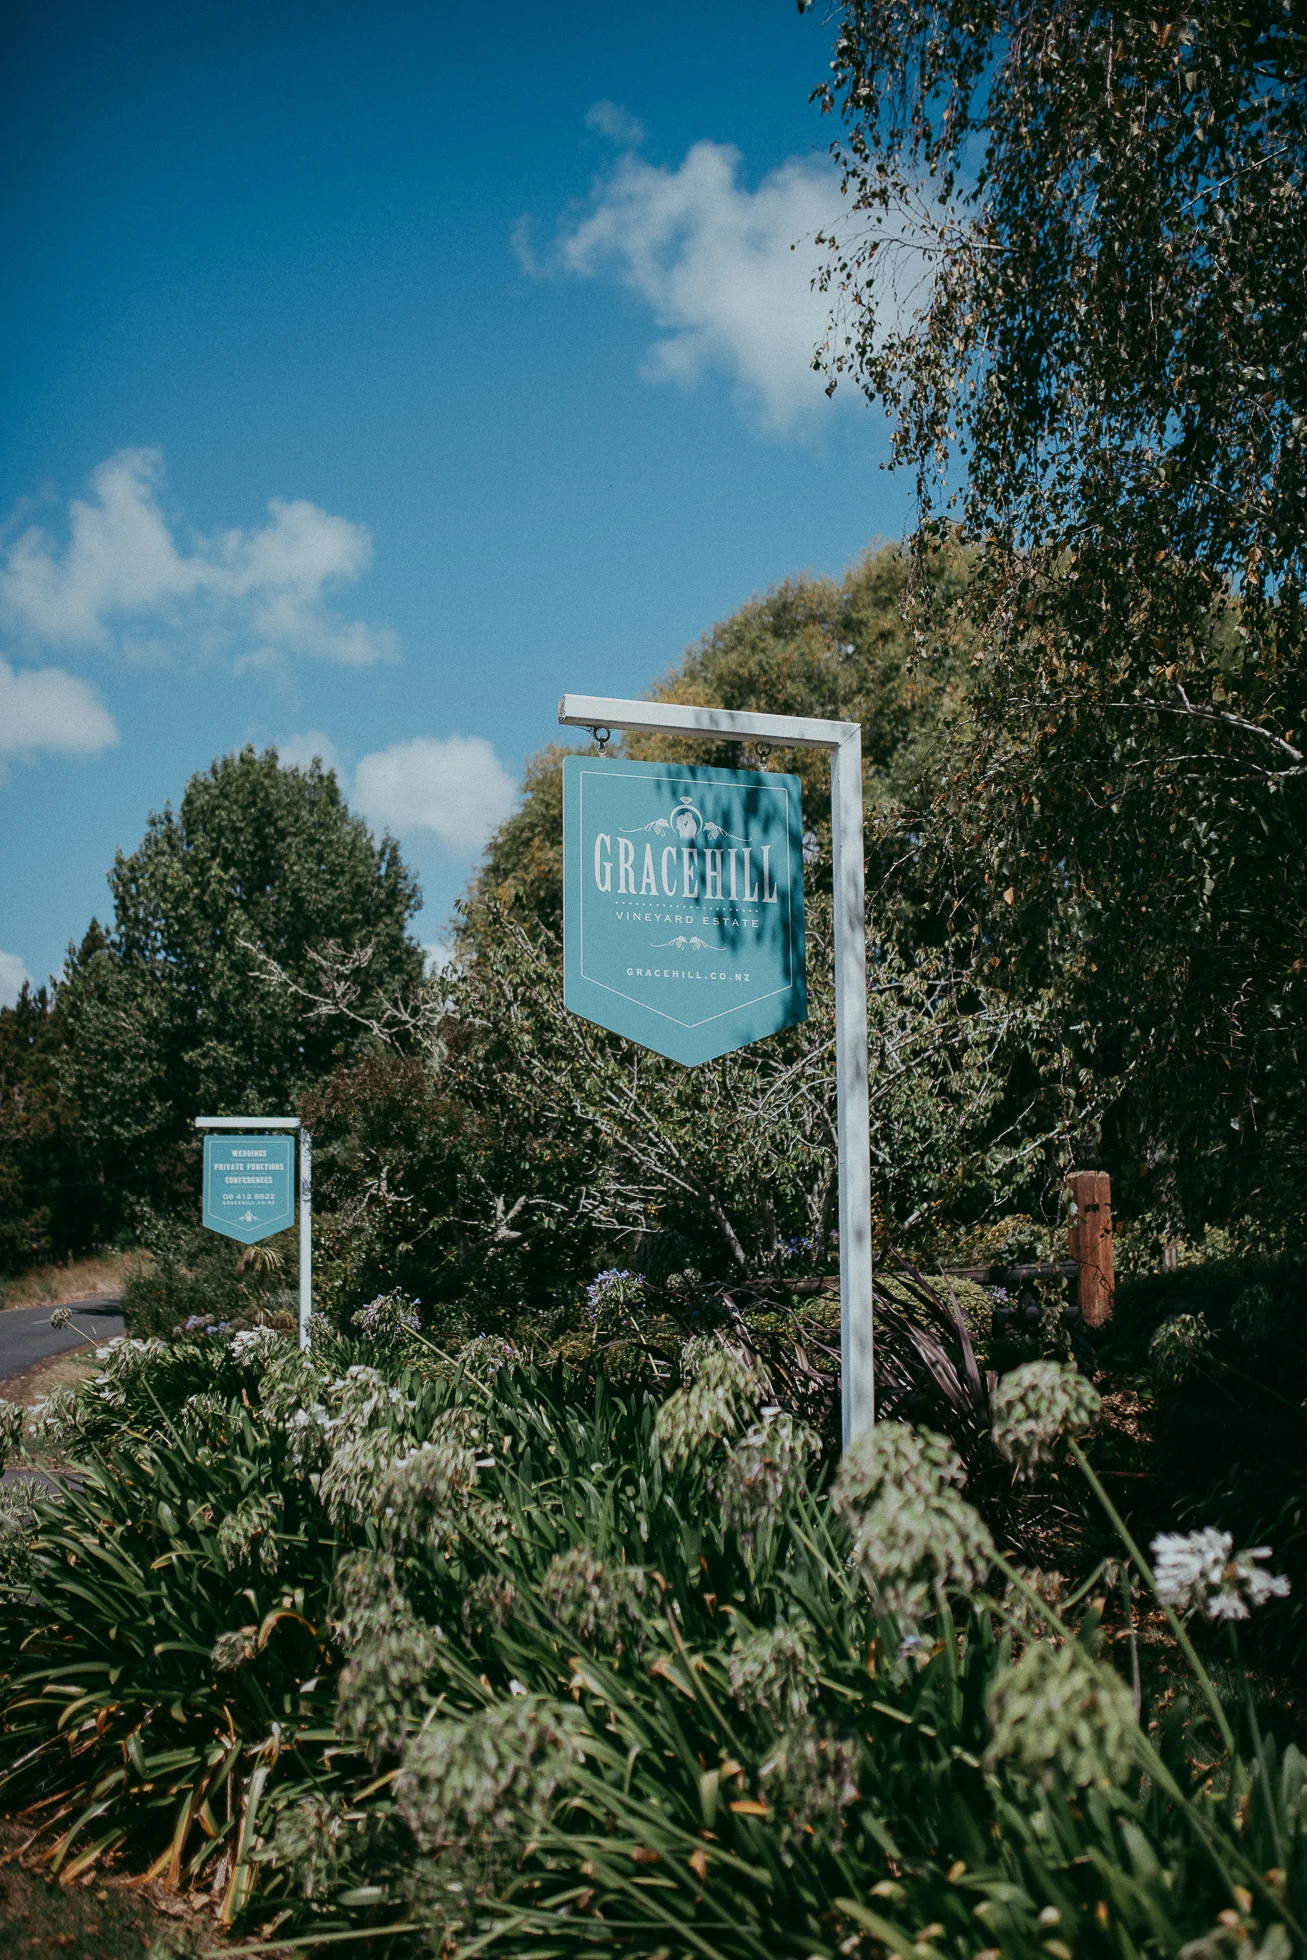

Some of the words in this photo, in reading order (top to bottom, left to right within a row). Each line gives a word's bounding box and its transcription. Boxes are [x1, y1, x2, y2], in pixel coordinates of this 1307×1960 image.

[594, 832, 778, 904] GRACEHILL
[615, 911, 694, 924] VINEYARD
[702, 916, 759, 928] ESTATE
[626, 967, 751, 982] GRACEHILL.CO.NZ
[231, 1149, 267, 1157] WEDDINGS
[214, 1163, 244, 1171] PRIVATE
[247, 1163, 285, 1171] FUNCTIONS
[225, 1176, 273, 1184] CONFERENCES
